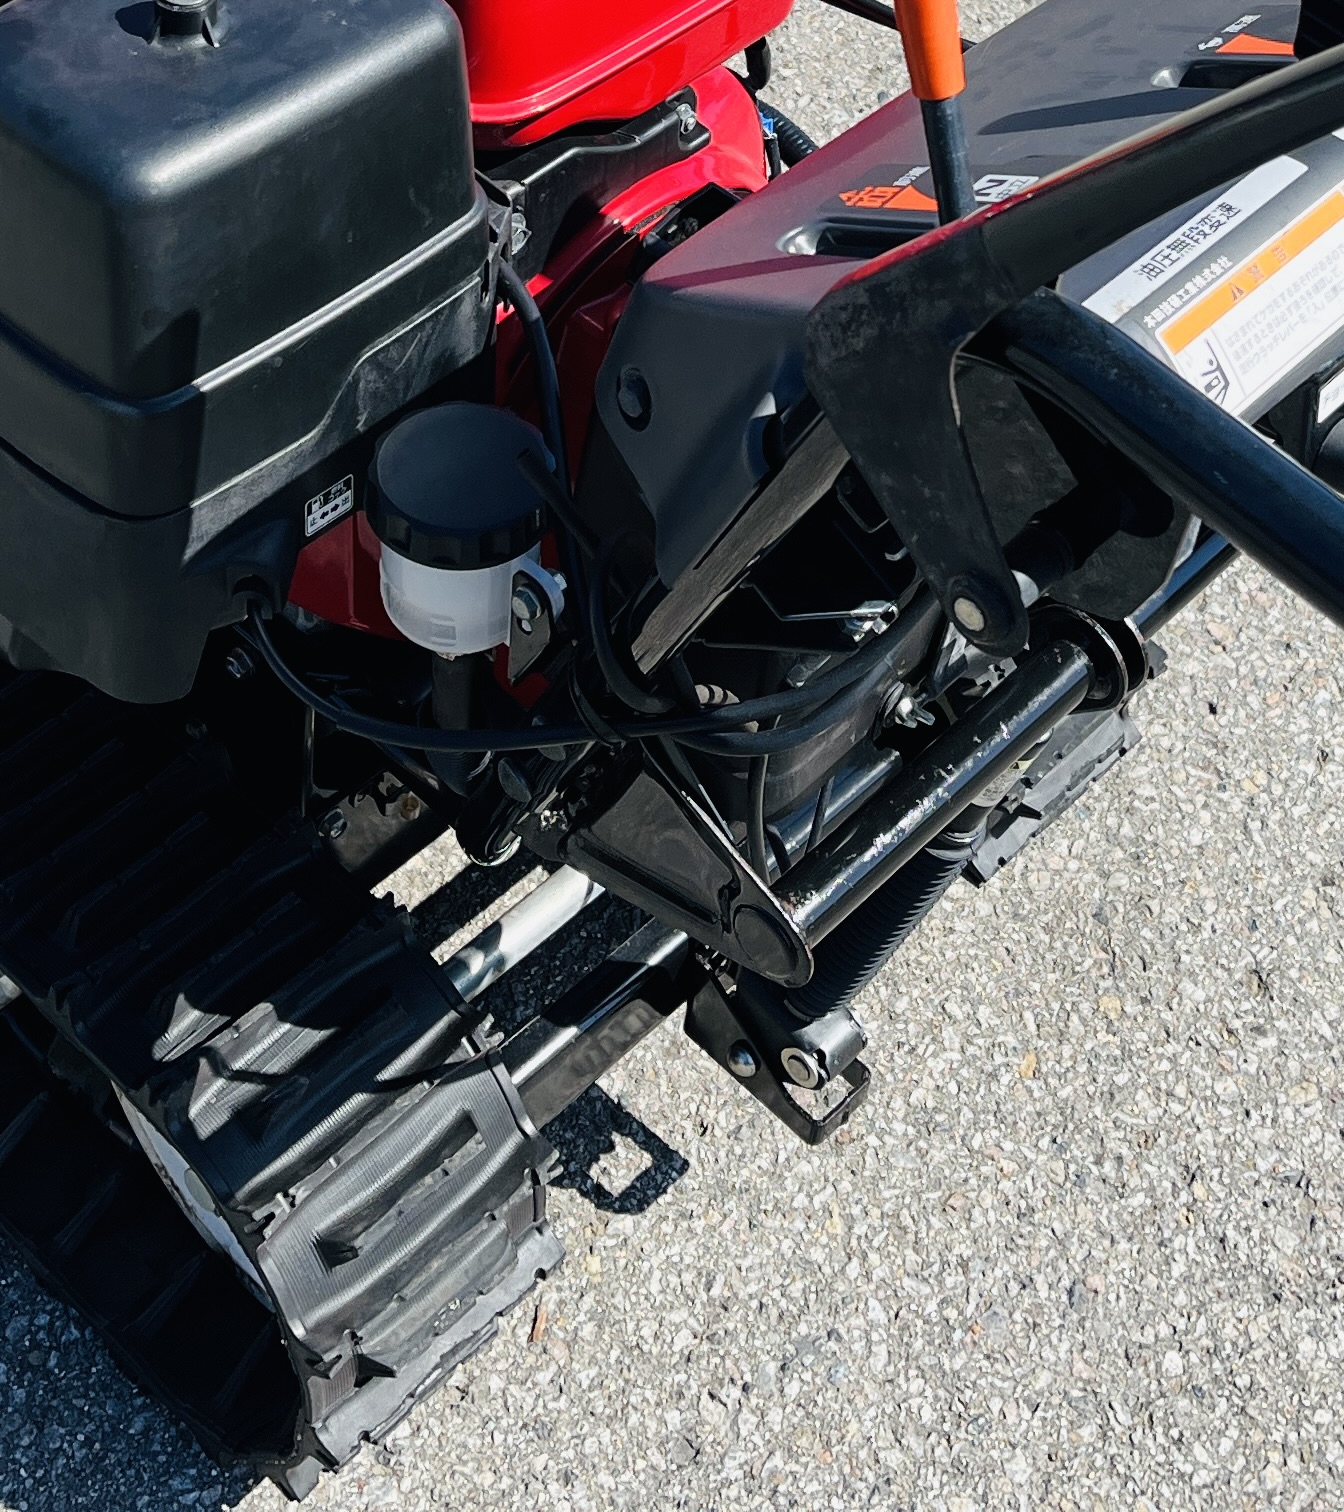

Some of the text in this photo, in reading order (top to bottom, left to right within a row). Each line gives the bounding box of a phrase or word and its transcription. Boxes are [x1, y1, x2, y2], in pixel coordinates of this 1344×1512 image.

[974, 178, 1008, 197] N
[1133, 201, 1243, 281] 油圧無段変速
[1143, 255, 1234, 329] 本田技研工業株式会社
